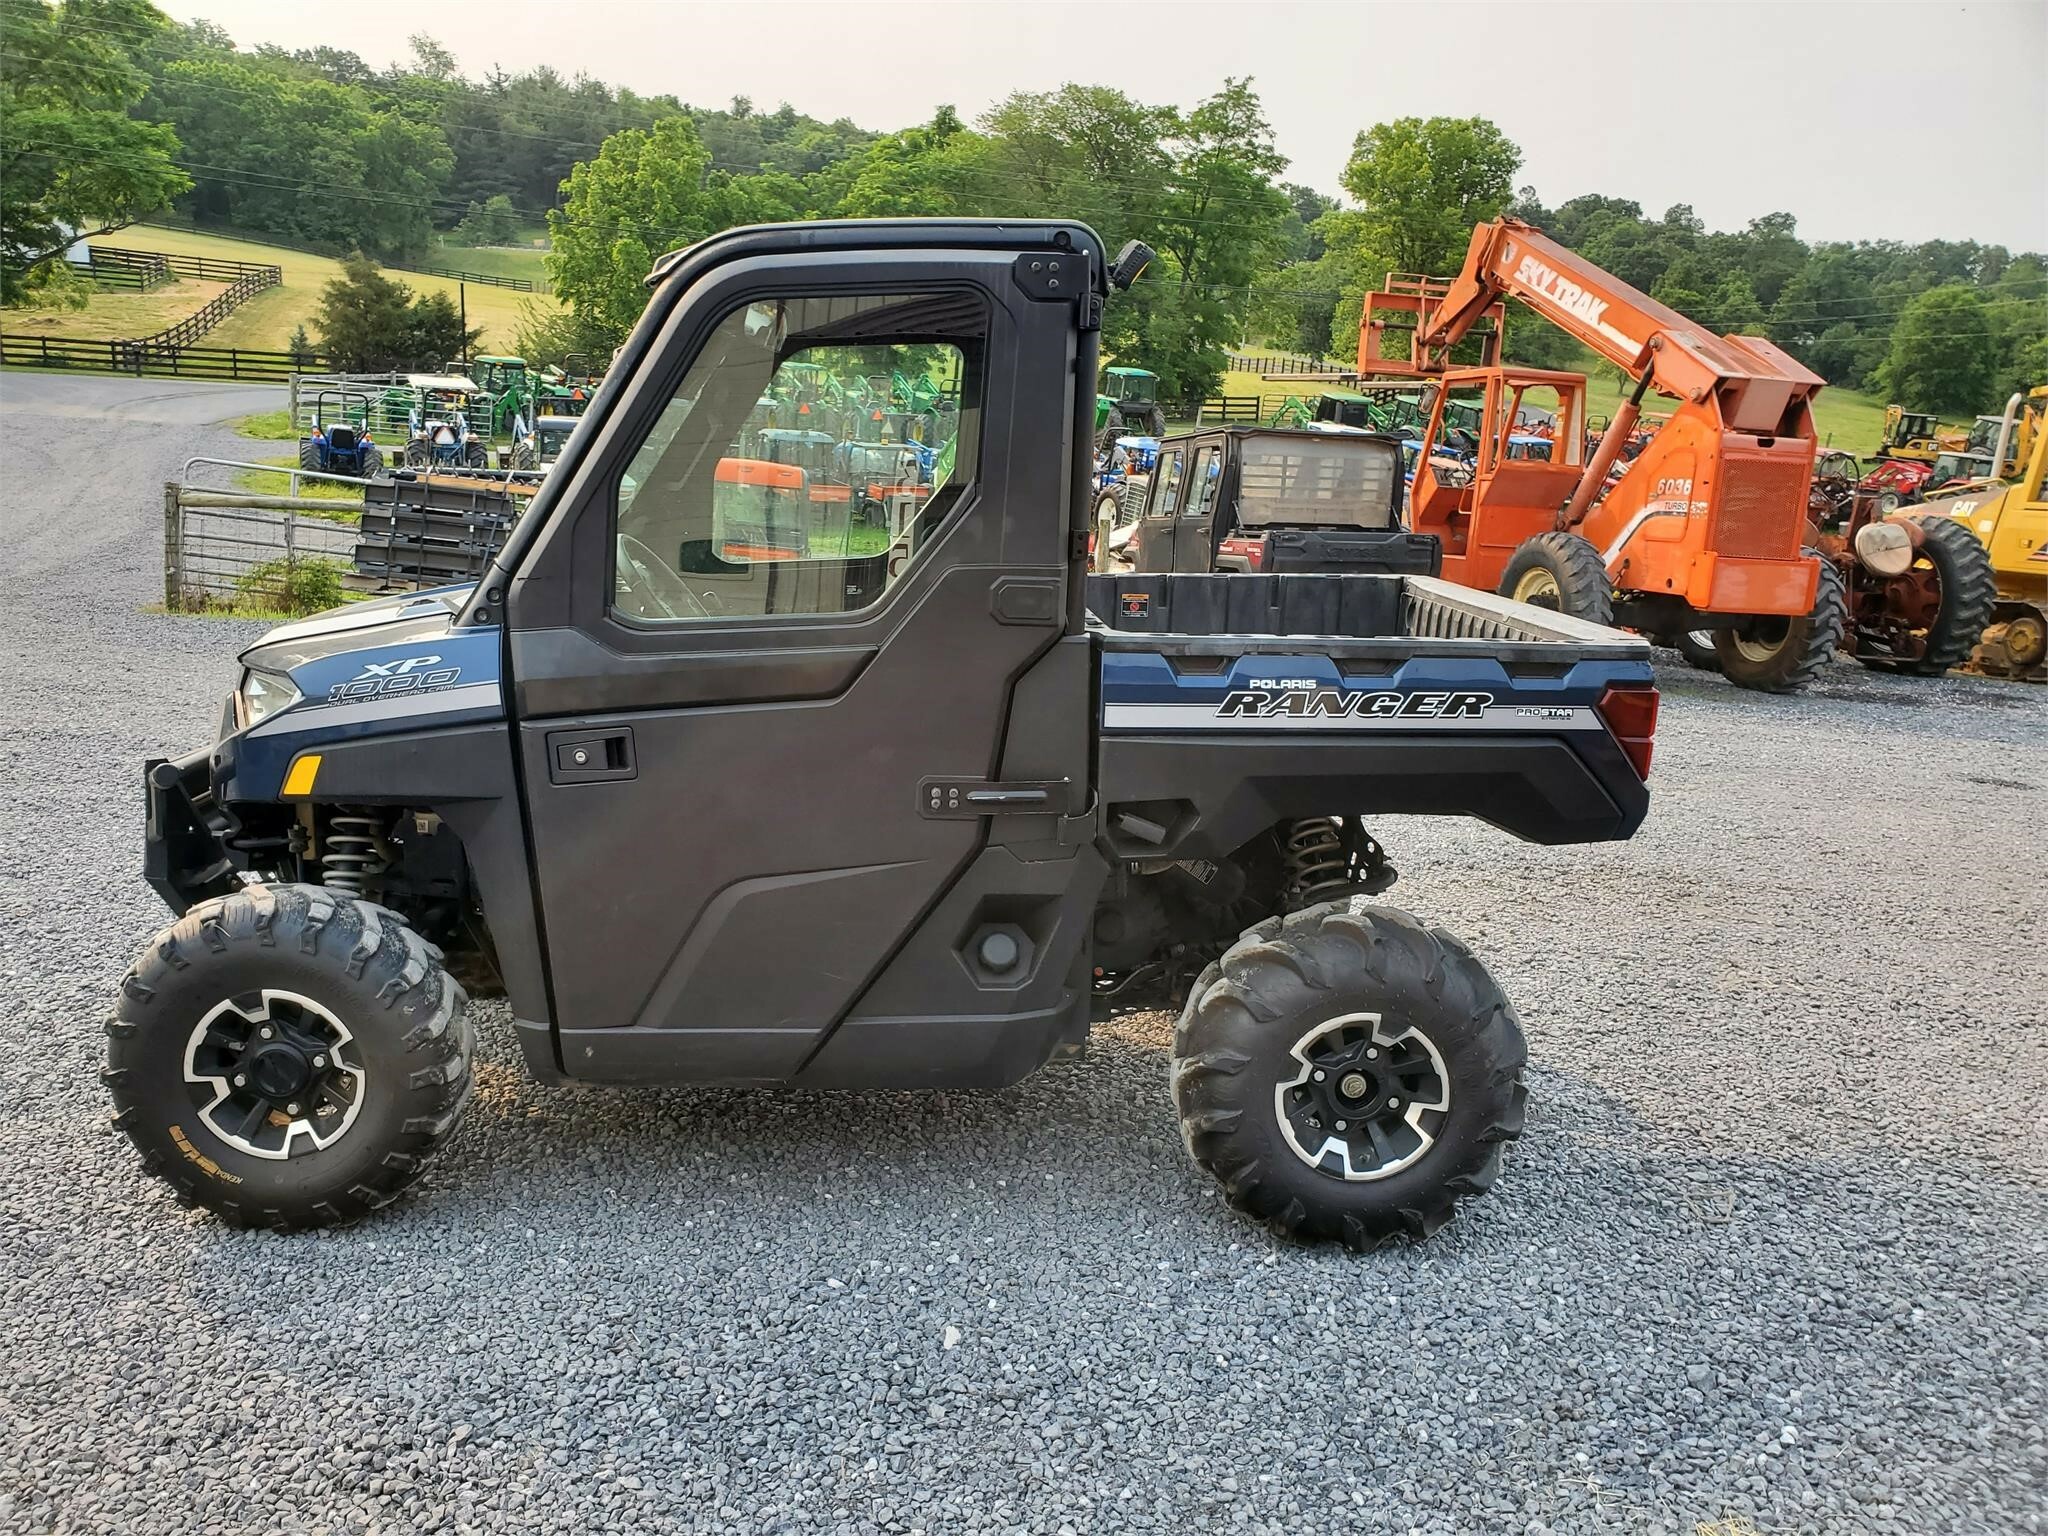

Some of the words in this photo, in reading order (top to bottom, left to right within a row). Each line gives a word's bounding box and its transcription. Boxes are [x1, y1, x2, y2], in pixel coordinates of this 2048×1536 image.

[1656, 478, 1693, 496] 6036
[1664, 501, 1688, 511] TURBO
[1950, 501, 1979, 517] CAT
[351, 655, 442, 681] XP
[327, 667, 462, 702] 1000
[1249, 679, 1317, 690] POLARIS
[329, 698, 360, 707] DUAL
[363, 688, 426, 703] OVERHEAD
[427, 684, 455, 694] CAM
[1214, 691, 1494, 719] RANGER
[1515, 707, 1575, 717] PROSTAR
[216, 1168, 244, 1185] KENDA
